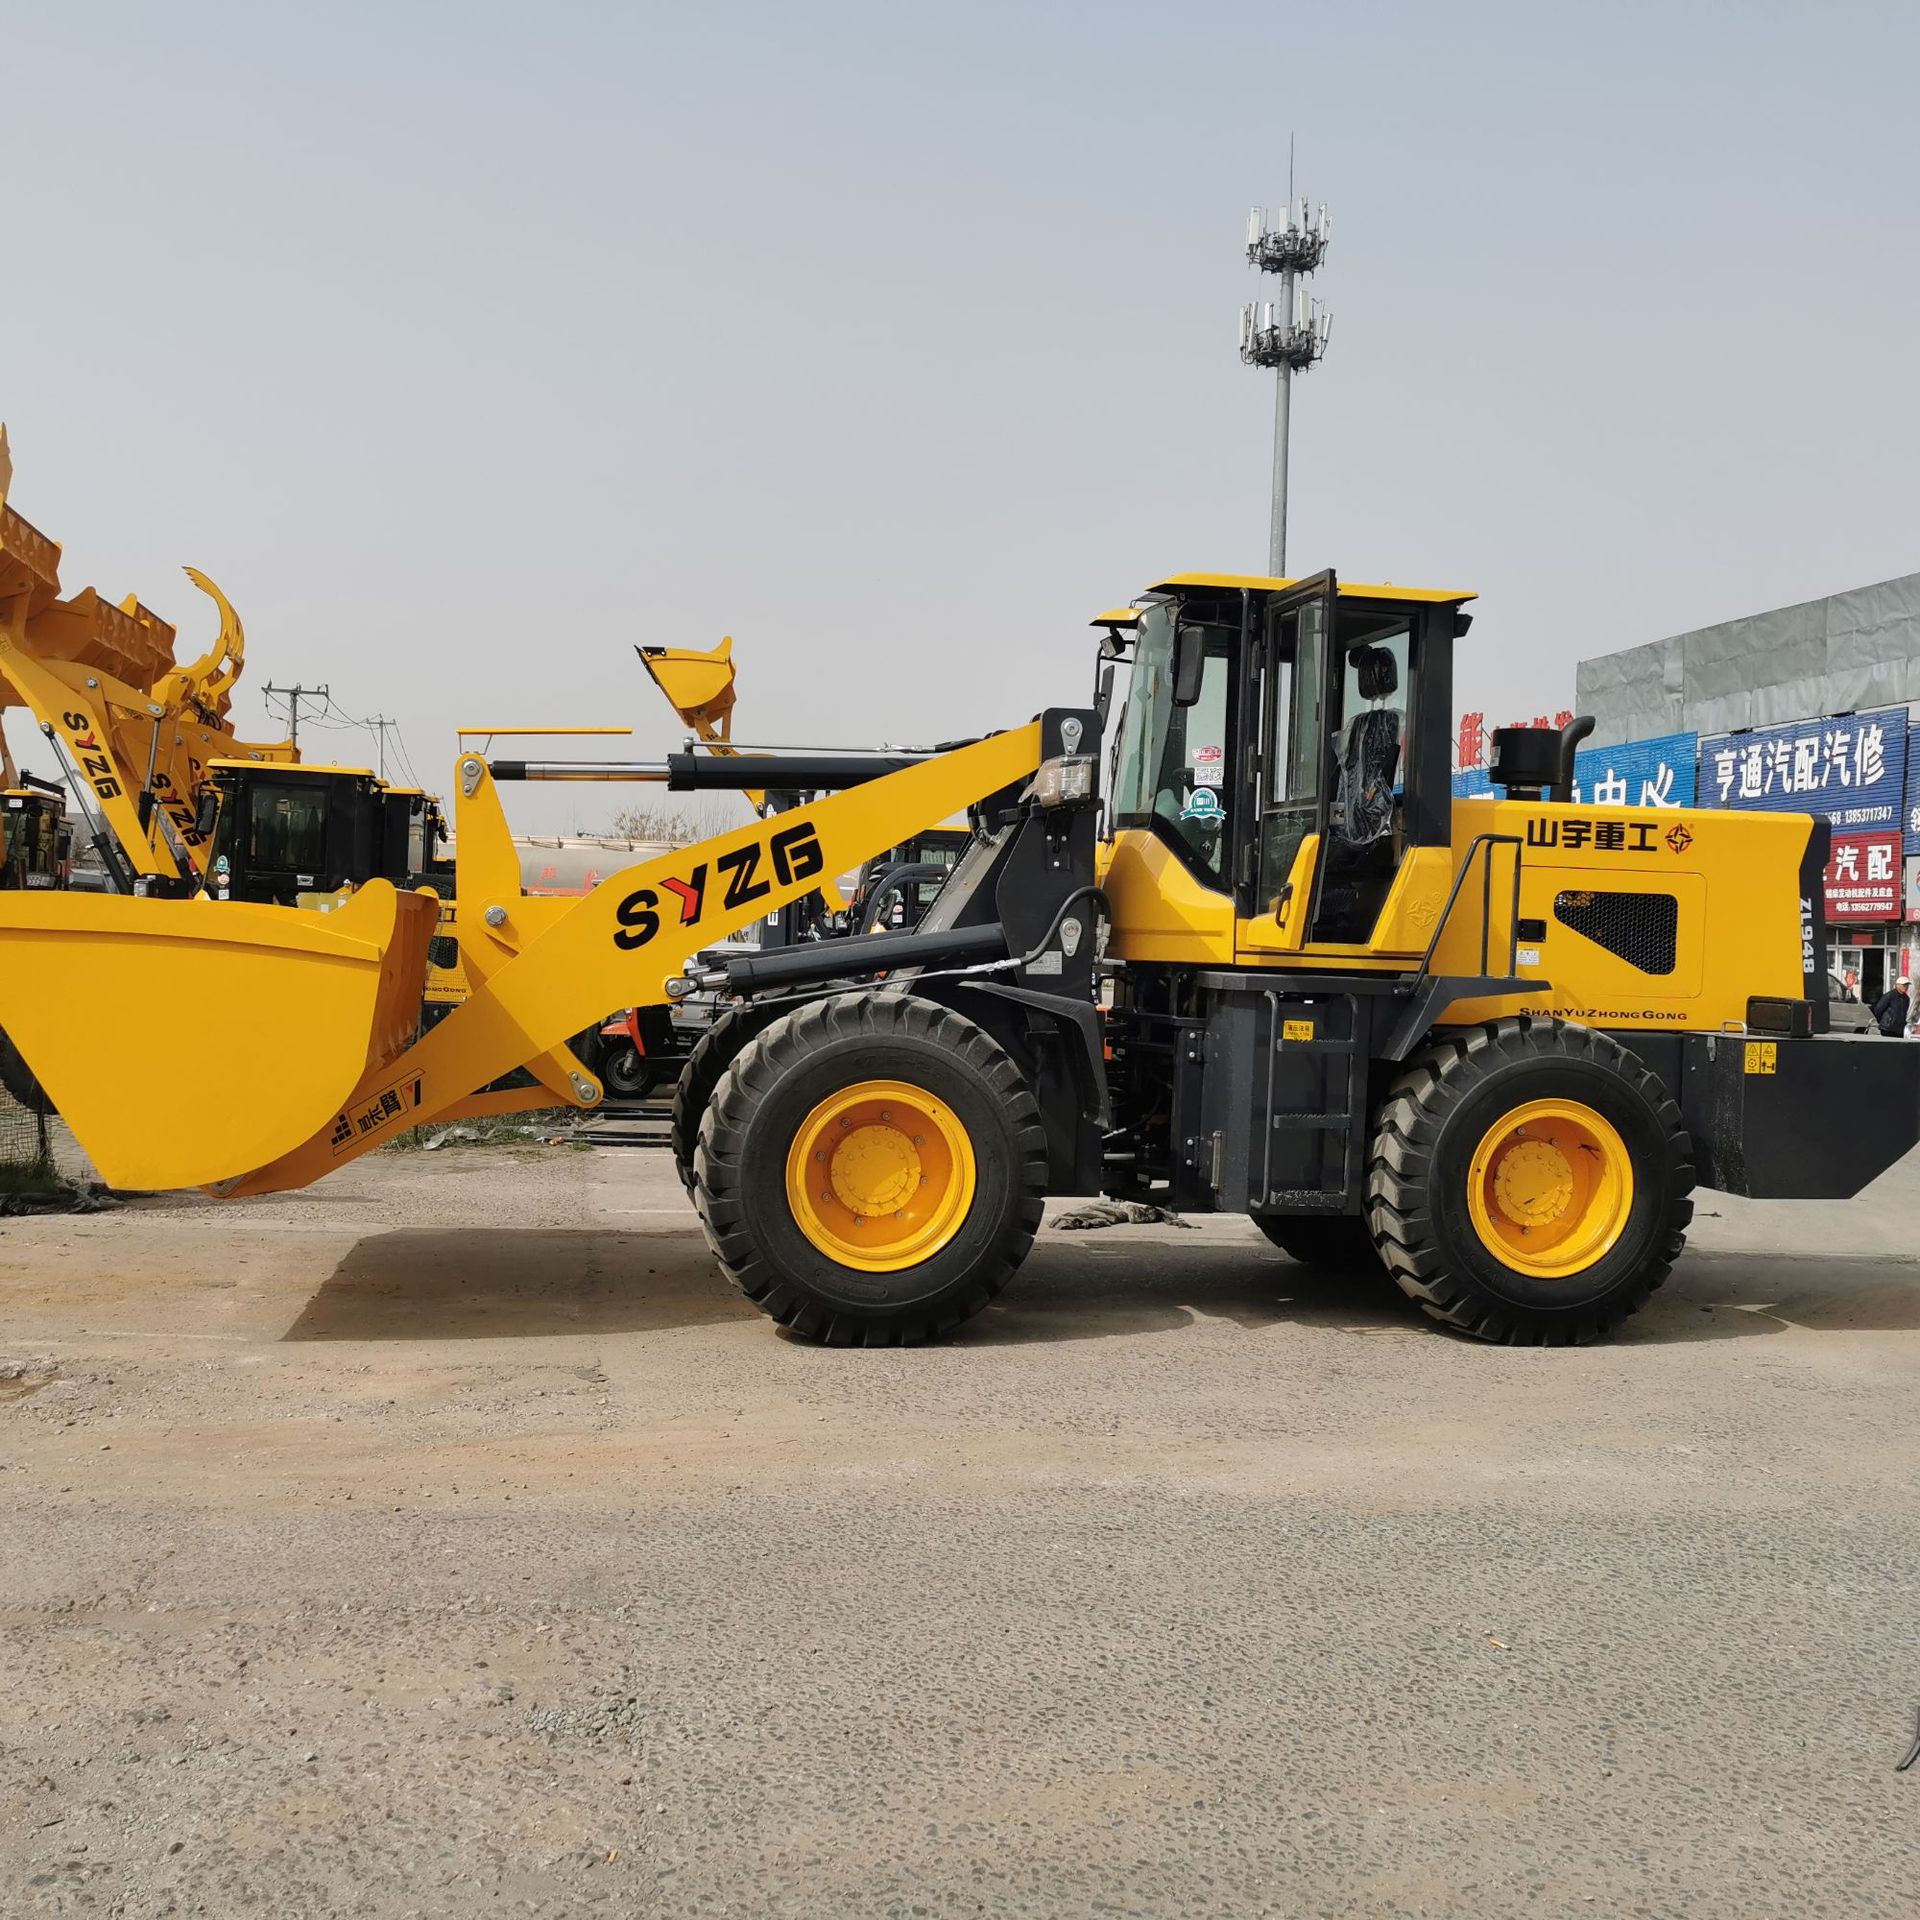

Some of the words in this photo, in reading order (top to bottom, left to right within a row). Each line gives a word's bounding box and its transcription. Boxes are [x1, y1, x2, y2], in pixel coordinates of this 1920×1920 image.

[63, 711, 122, 800] SYZG
[1714, 723, 1886, 803] 亨通汽配汽修
[1526, 818, 1659, 852] 山宇重工
[613, 821, 824, 950] SYZG
[1800, 897, 1815, 974] ZL948
